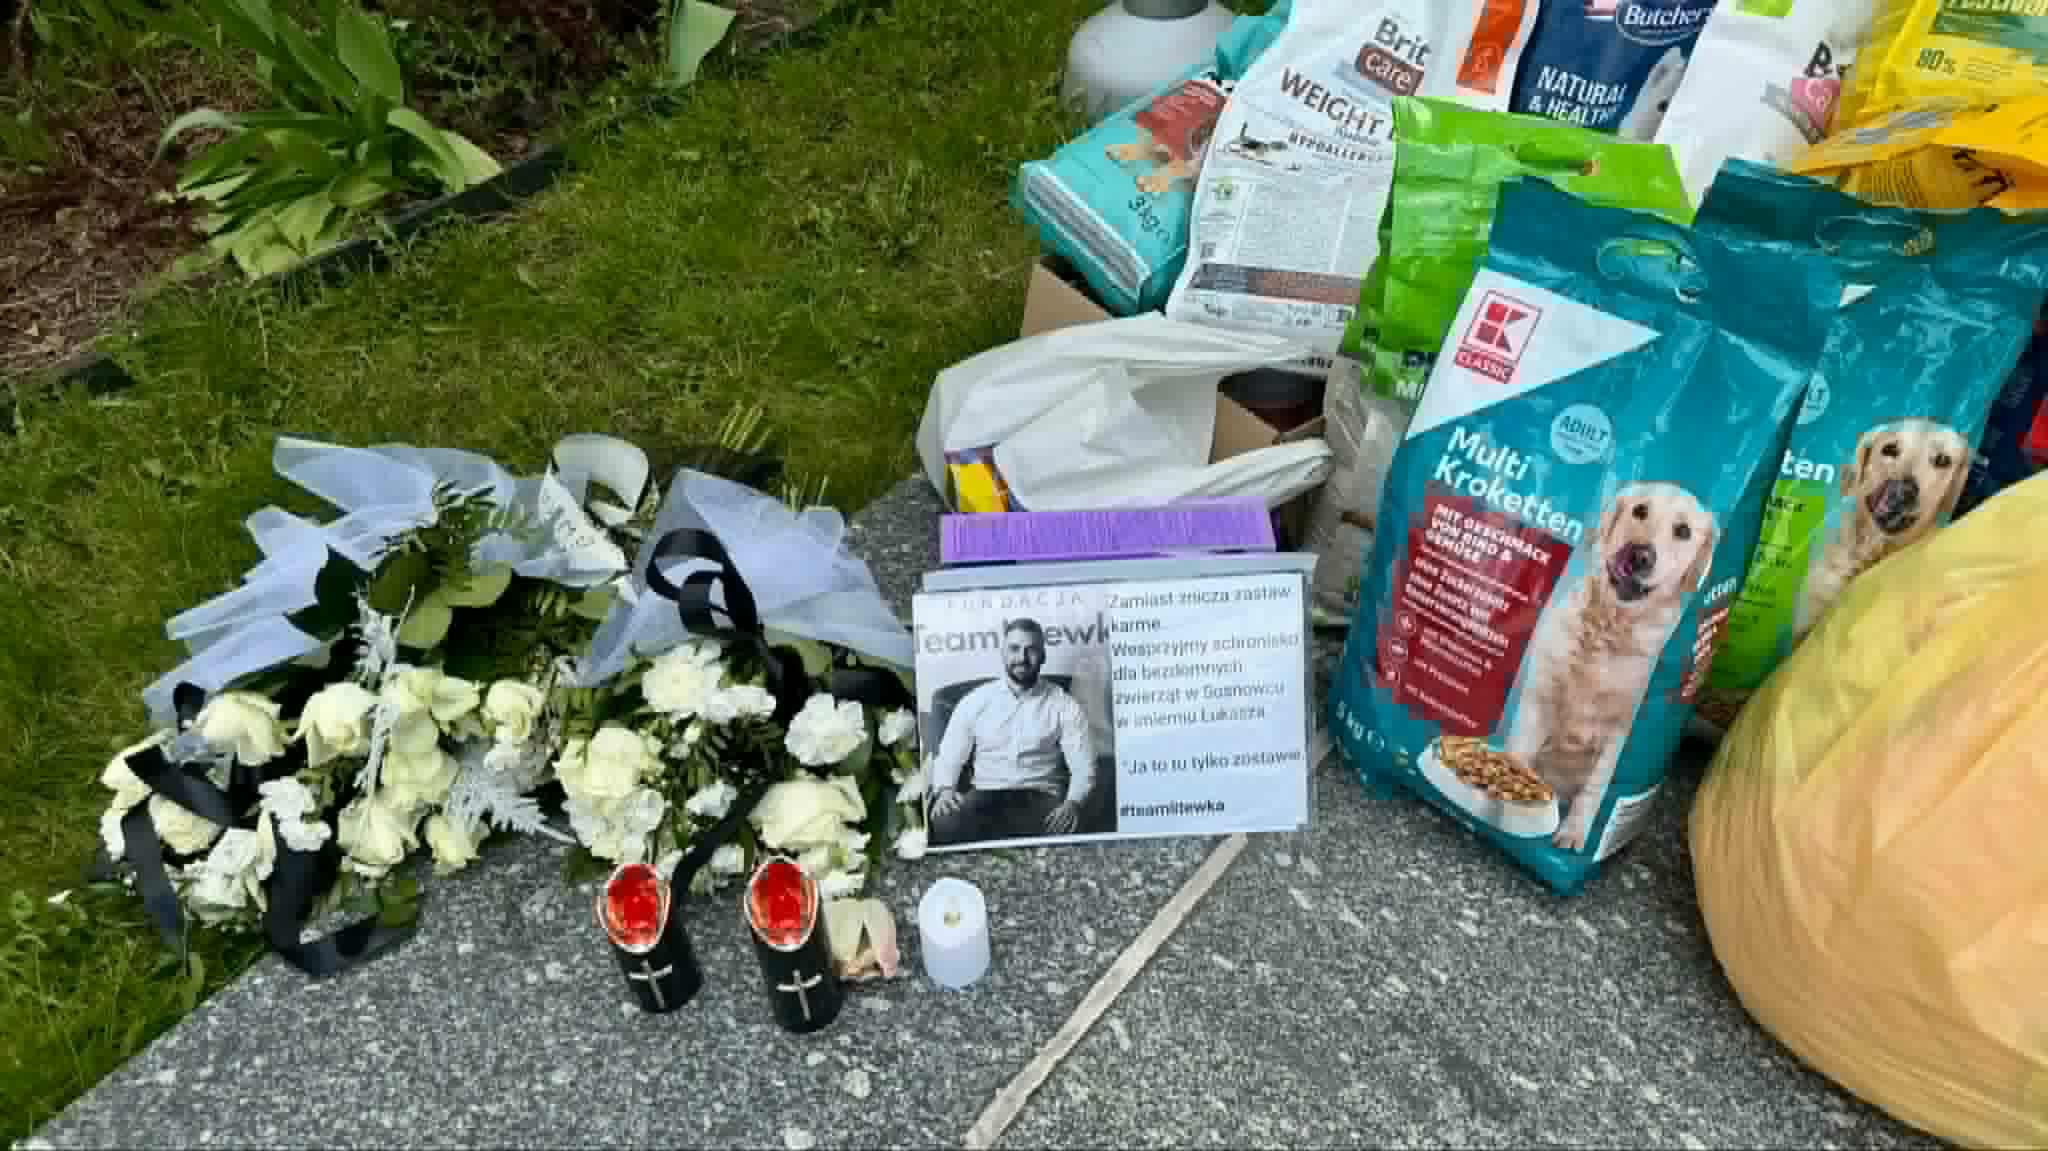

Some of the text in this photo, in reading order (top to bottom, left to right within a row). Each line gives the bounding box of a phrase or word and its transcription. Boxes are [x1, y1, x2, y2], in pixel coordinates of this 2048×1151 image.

[1373, 16, 1432, 66] Brit
[1280, 68, 1385, 136] WEIGHT
[1455, 350, 1514, 384] CLASSIC
[1559, 414, 1609, 441] ADULT
[1447, 424, 1531, 481] Multi
[1780, 449, 1836, 484] ten
[1434, 453, 1585, 543] Kroketten
[1109, 590, 1174, 609] Zamiast
[1111, 632, 1300, 658] Wesprzyjmy schronisko
[1112, 658, 1243, 682] dla bezdomnych
[1186, 688, 1201, 700] w
[1202, 680, 1286, 701] Sosnowcu
[1116, 716, 1130, 729] w
[1151, 759, 1169, 773] to
[1191, 752, 1230, 772] tylko
[1119, 799, 1225, 818] #teamlitewka
